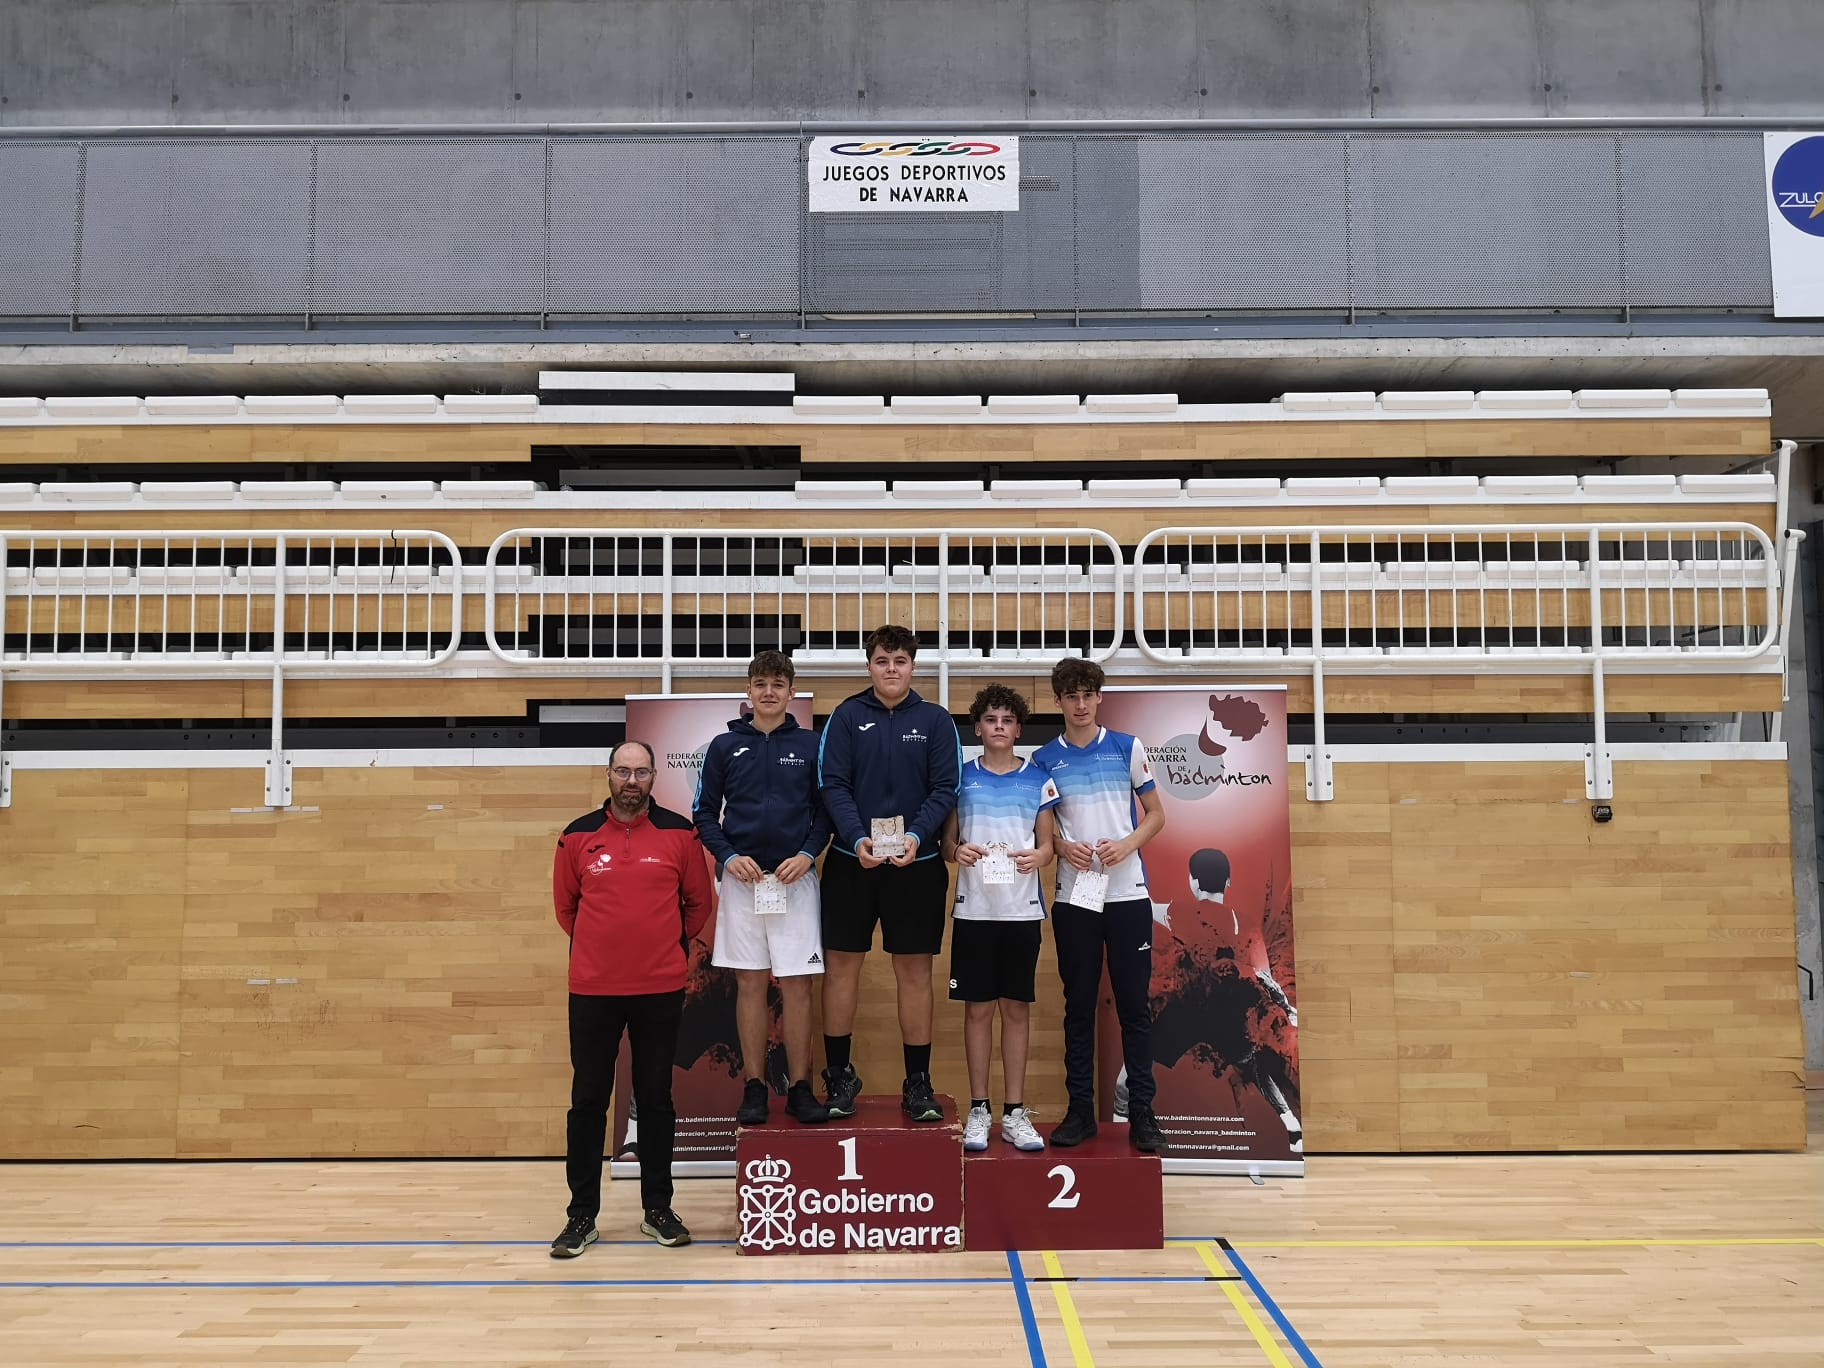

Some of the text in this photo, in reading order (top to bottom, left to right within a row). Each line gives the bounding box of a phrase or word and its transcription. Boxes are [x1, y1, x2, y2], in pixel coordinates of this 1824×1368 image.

[823, 165, 1006, 181] JUEGOS DEPORTIVOS
[859, 187, 969, 202] DE NAVARRA
[667, 752, 706, 760] FEDERACI
[838, 1136, 864, 1181] 1
[1047, 1164, 1081, 1208] 2
[799, 1188, 934, 1214] Gobierno
[800, 1223, 961, 1248] de Navarra
